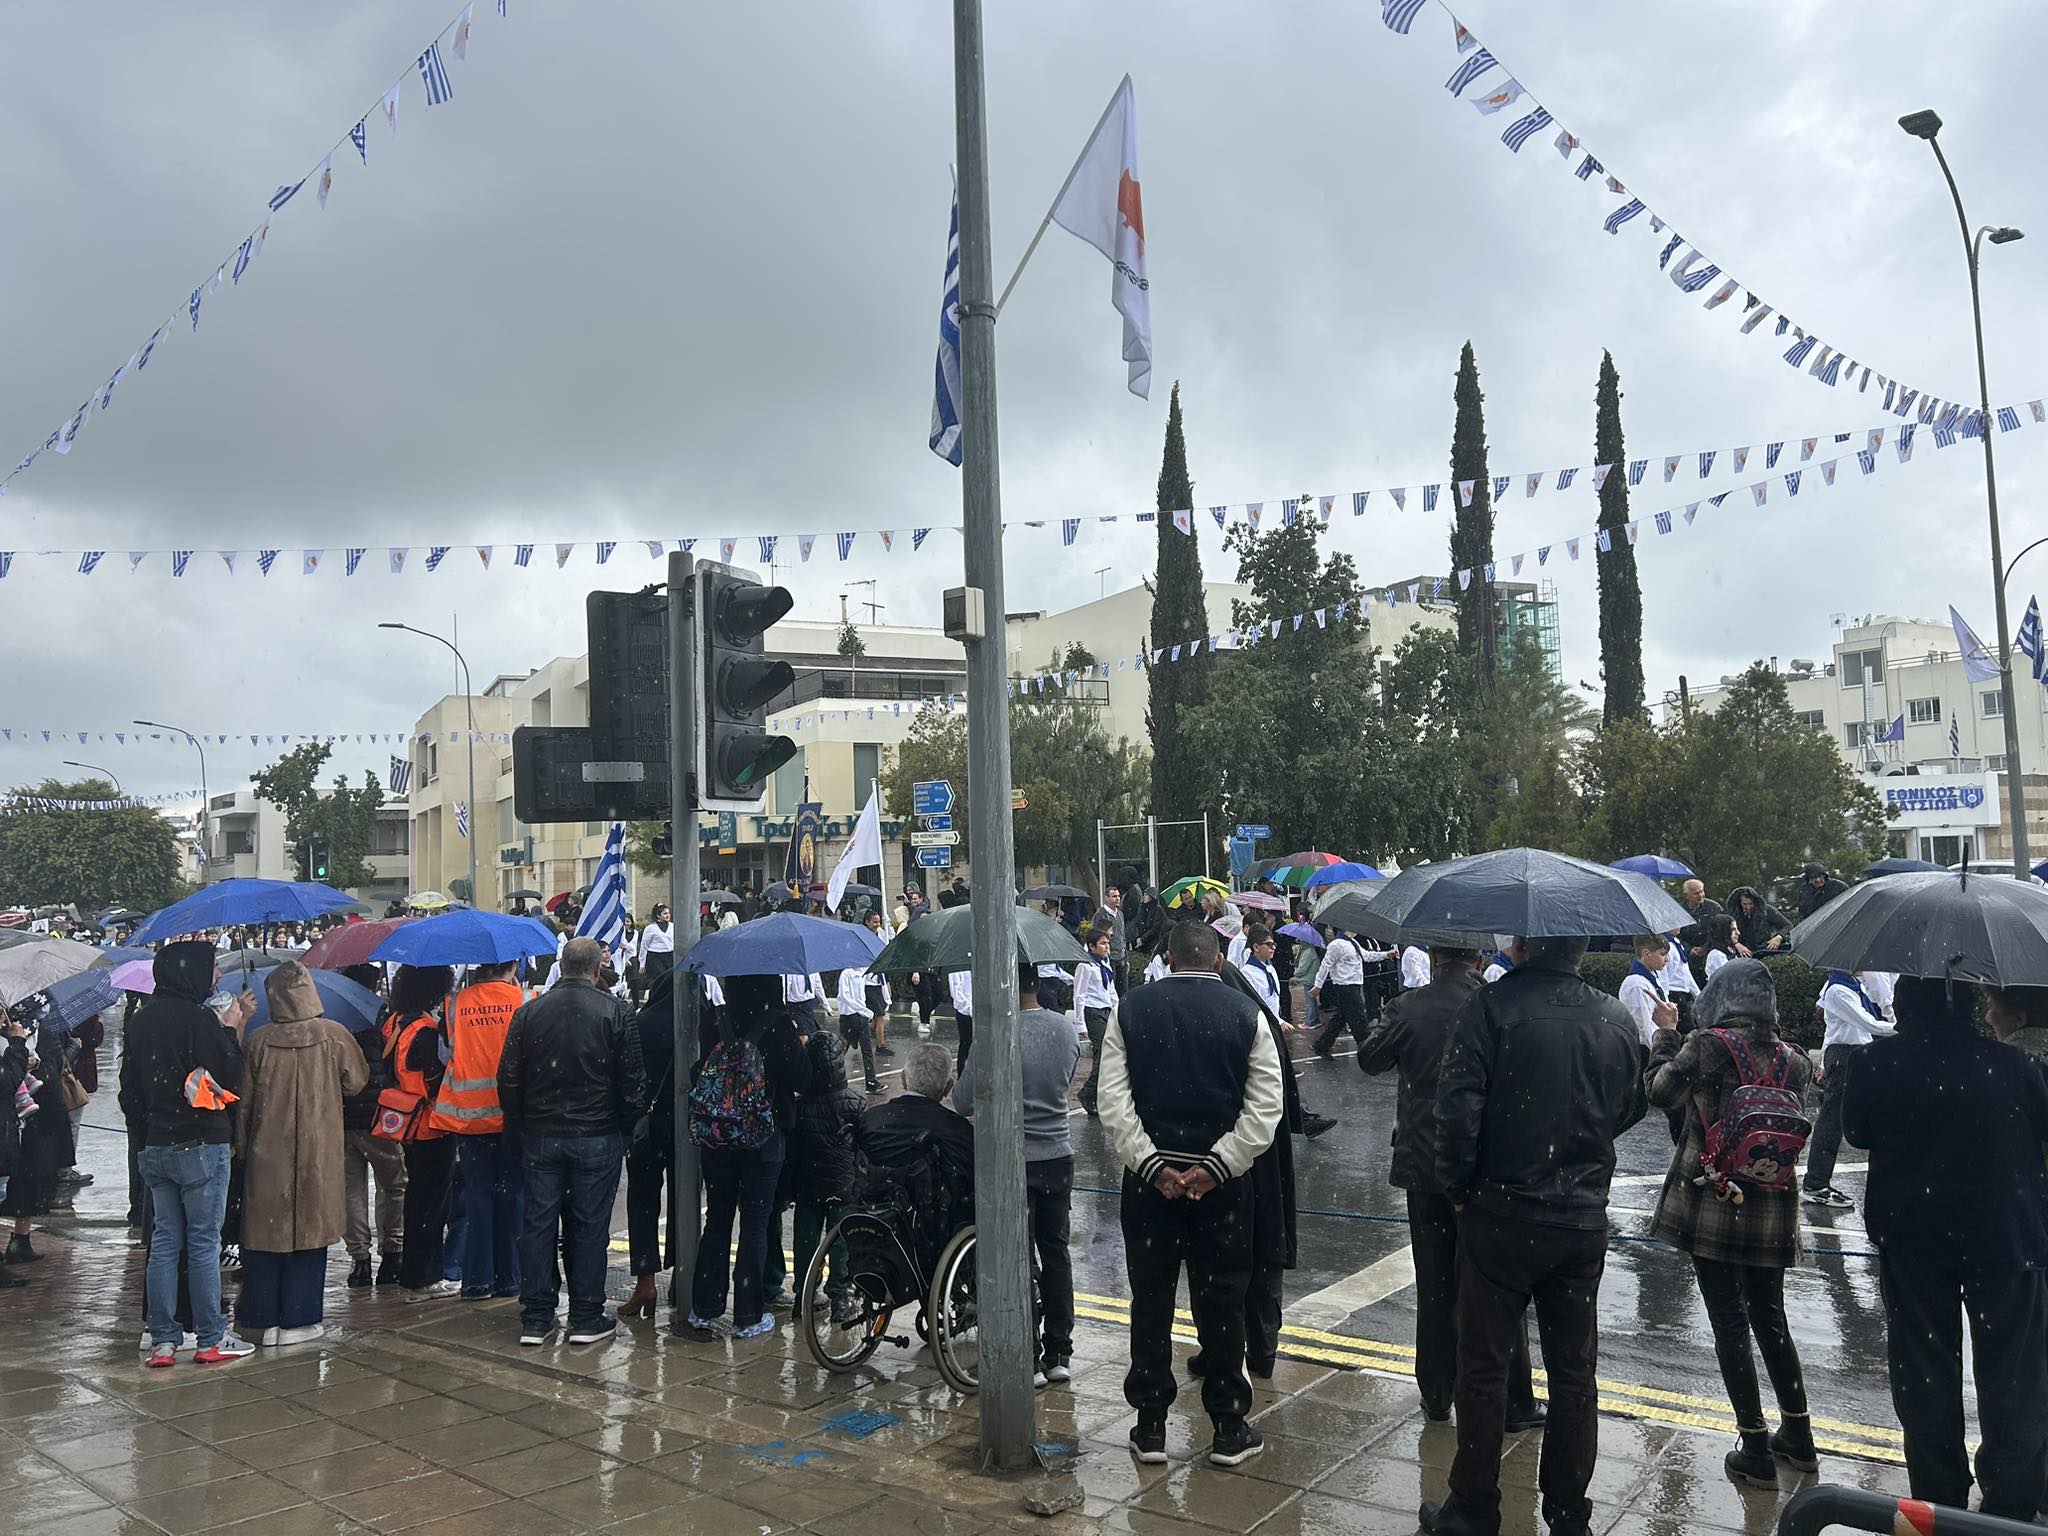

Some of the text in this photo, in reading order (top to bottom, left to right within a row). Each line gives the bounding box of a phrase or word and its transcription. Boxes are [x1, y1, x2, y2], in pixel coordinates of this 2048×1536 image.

[1887, 787, 1957, 801] ΕΘΝΙΚΟΣ
[1892, 798, 1958, 811] ΑΤΣΙΩΝ
[460, 1004, 513, 1017] ΠΟΛΙΤΙΚΗ
[468, 1016, 505, 1027] ΑΜΥΝΑ
